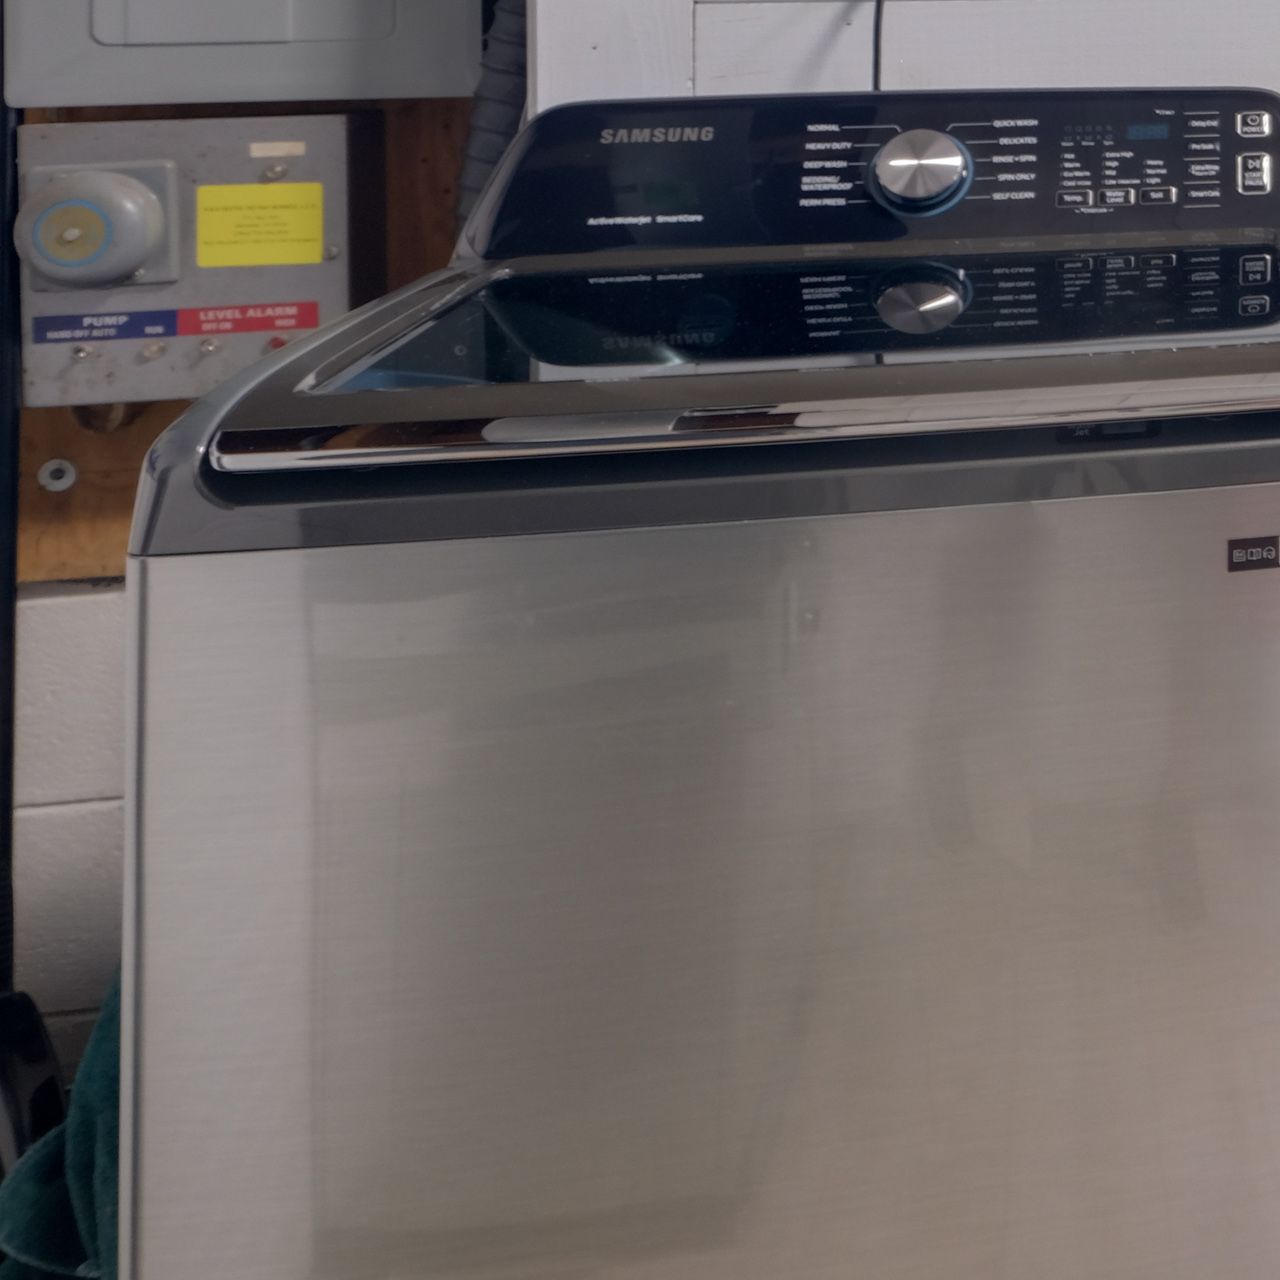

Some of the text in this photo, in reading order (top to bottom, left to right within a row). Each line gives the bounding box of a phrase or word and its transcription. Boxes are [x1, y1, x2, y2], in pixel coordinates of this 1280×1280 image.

[600, 126, 715, 144] SAMSUNG
[805, 142, 853, 150] HEAVY DUTY
[200, 306, 298, 320] LEVEL ALARM
[82, 315, 129, 327] PUMP
